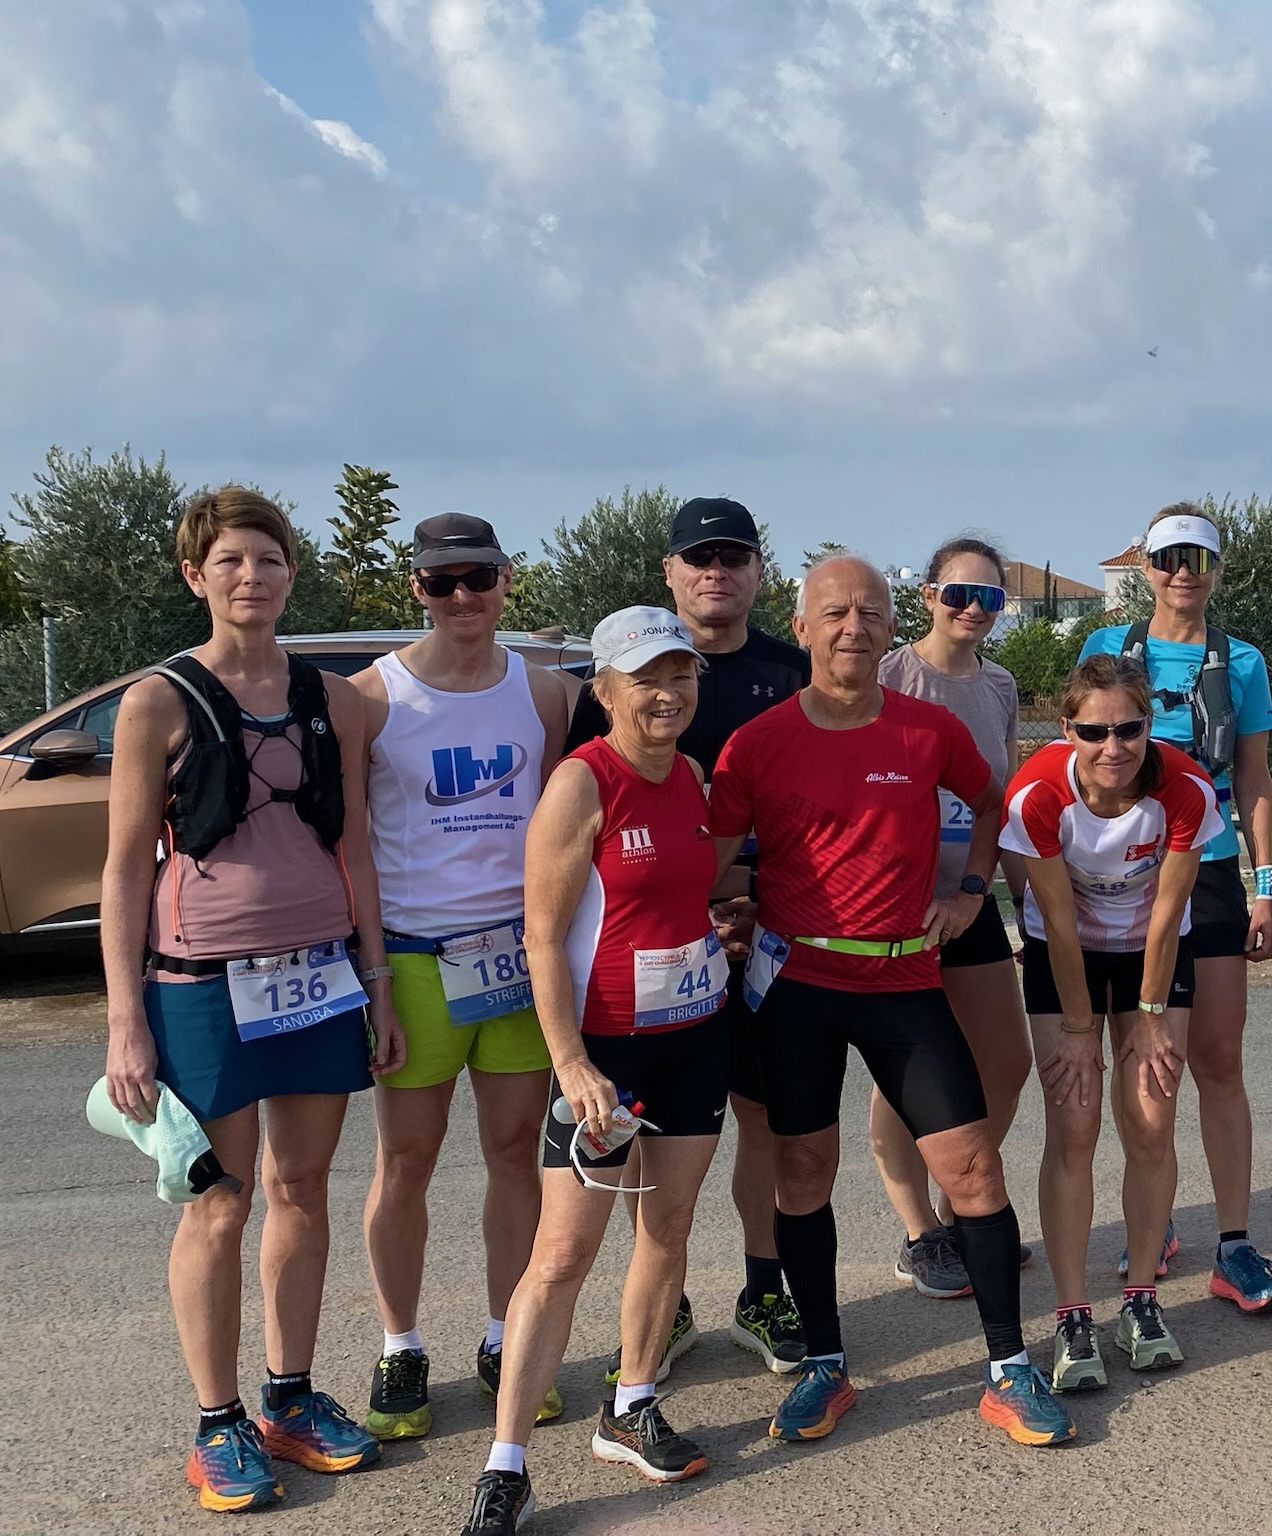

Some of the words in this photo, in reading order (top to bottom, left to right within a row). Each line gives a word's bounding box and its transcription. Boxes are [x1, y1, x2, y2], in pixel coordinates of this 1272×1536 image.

[431, 816, 450, 826] IHM
[444, 823, 503, 833] Management
[505, 822, 515, 830] AG
[622, 847, 656, 858] athlon
[473, 949, 529, 986] 180
[265, 972, 327, 1012] 136
[677, 964, 712, 999] 44
[272, 1006, 334, 1032] SANDRA
[668, 996, 718, 1021] BRIGITTE
